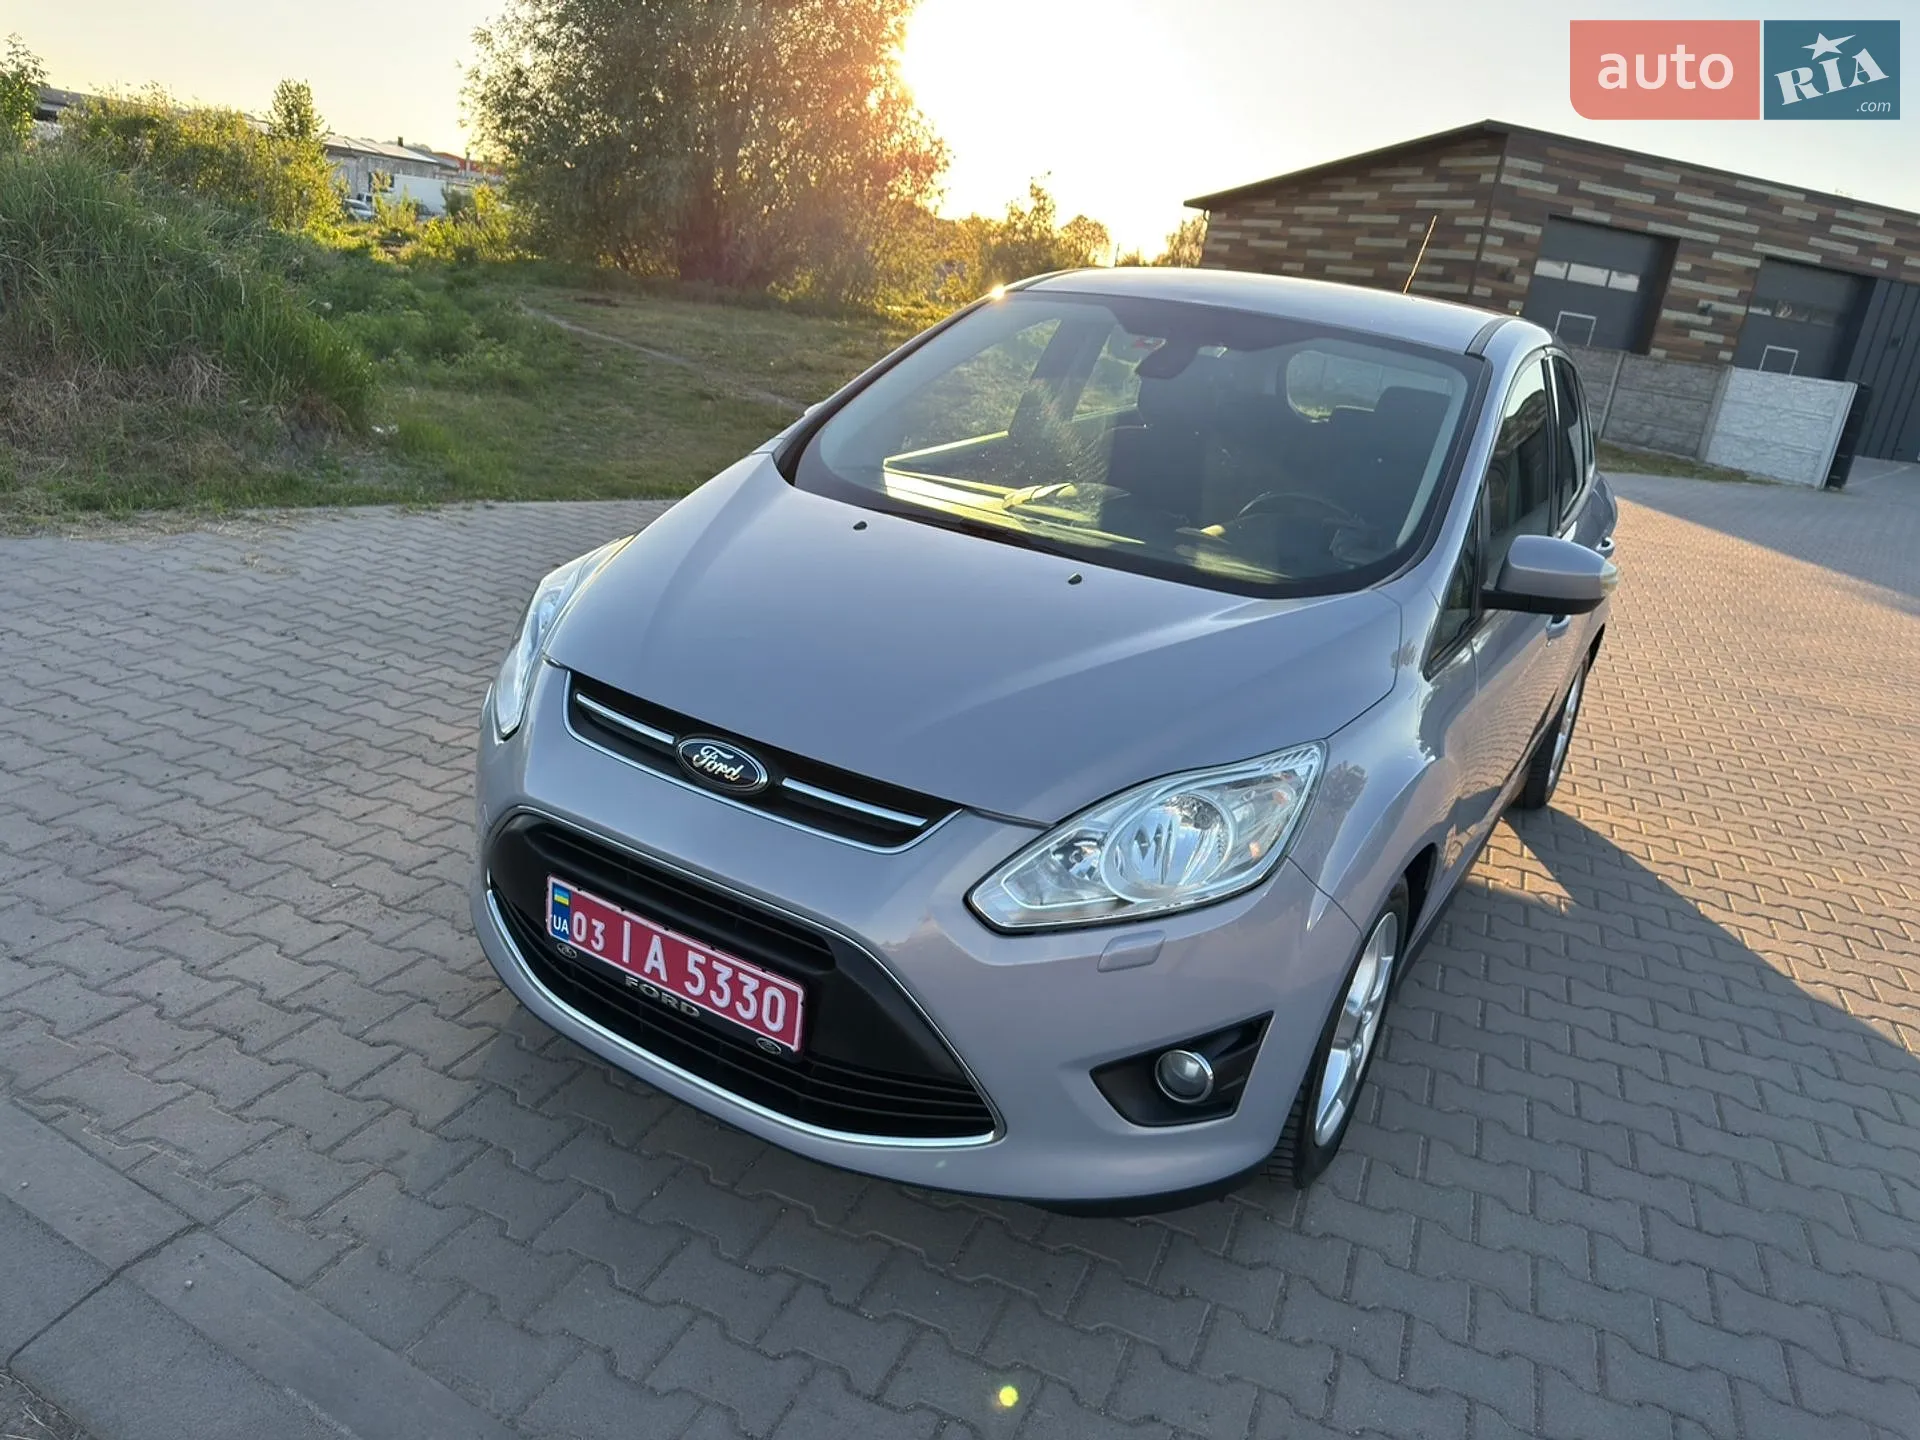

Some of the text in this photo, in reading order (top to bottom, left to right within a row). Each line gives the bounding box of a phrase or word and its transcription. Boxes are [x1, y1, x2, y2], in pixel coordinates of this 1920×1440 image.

[692, 745, 745, 781] Ford
[553, 914, 569, 935] UA
[572, 911, 605, 951] 03
[684, 950, 786, 1032] 5330
[624, 975, 700, 1018] FORD
